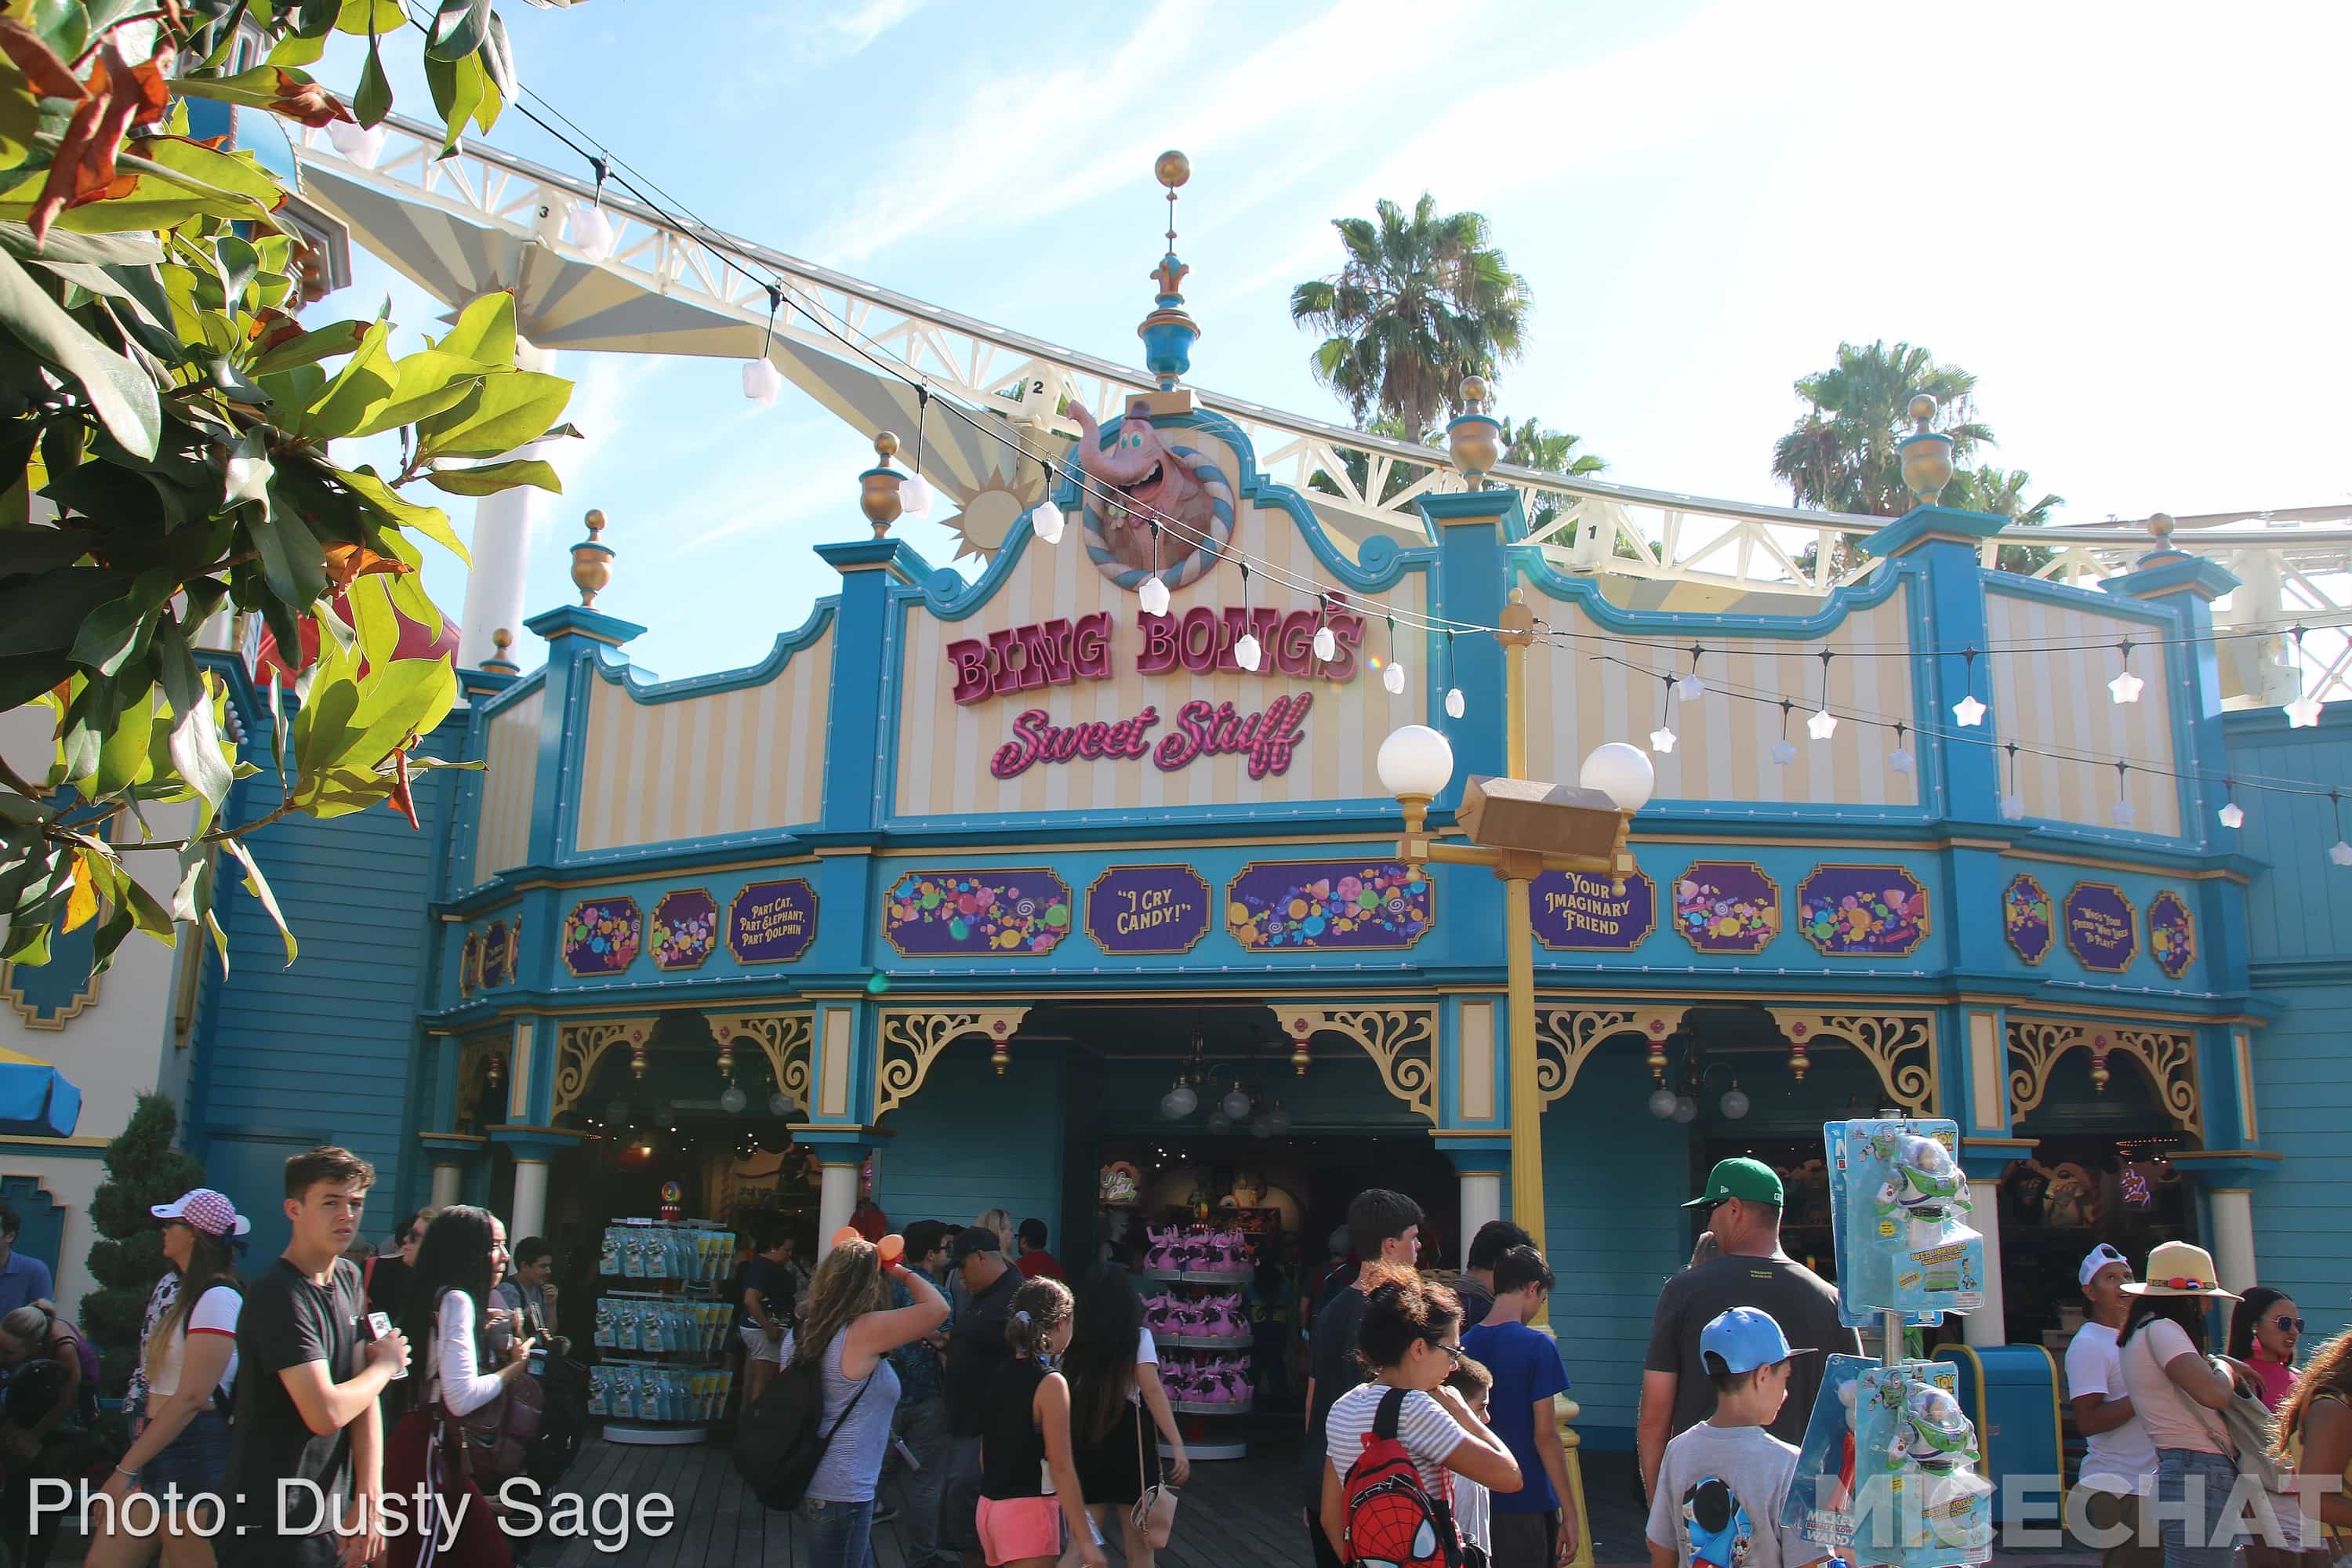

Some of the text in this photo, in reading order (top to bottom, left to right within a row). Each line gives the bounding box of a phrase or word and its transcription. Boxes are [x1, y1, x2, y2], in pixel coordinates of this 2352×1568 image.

[539, 205, 549, 218] 3
[1033, 380, 1044, 394] 2
[1588, 525, 1597, 539] 1
[946, 611, 1113, 706] BING
[990, 691, 1313, 780] Sweet Stuff
[1565, 871, 1610, 899] YOUR
[1142, 888, 1172, 910] CRY
[1544, 892, 1631, 917] IMAGINARY
[751, 902, 775, 920] PART
[1563, 909, 1620, 935] FRIEND
[739, 916, 762, 931] PART
[741, 924, 802, 947] PART DOLPHIN
[1933, 1374, 1957, 1388] TOY
